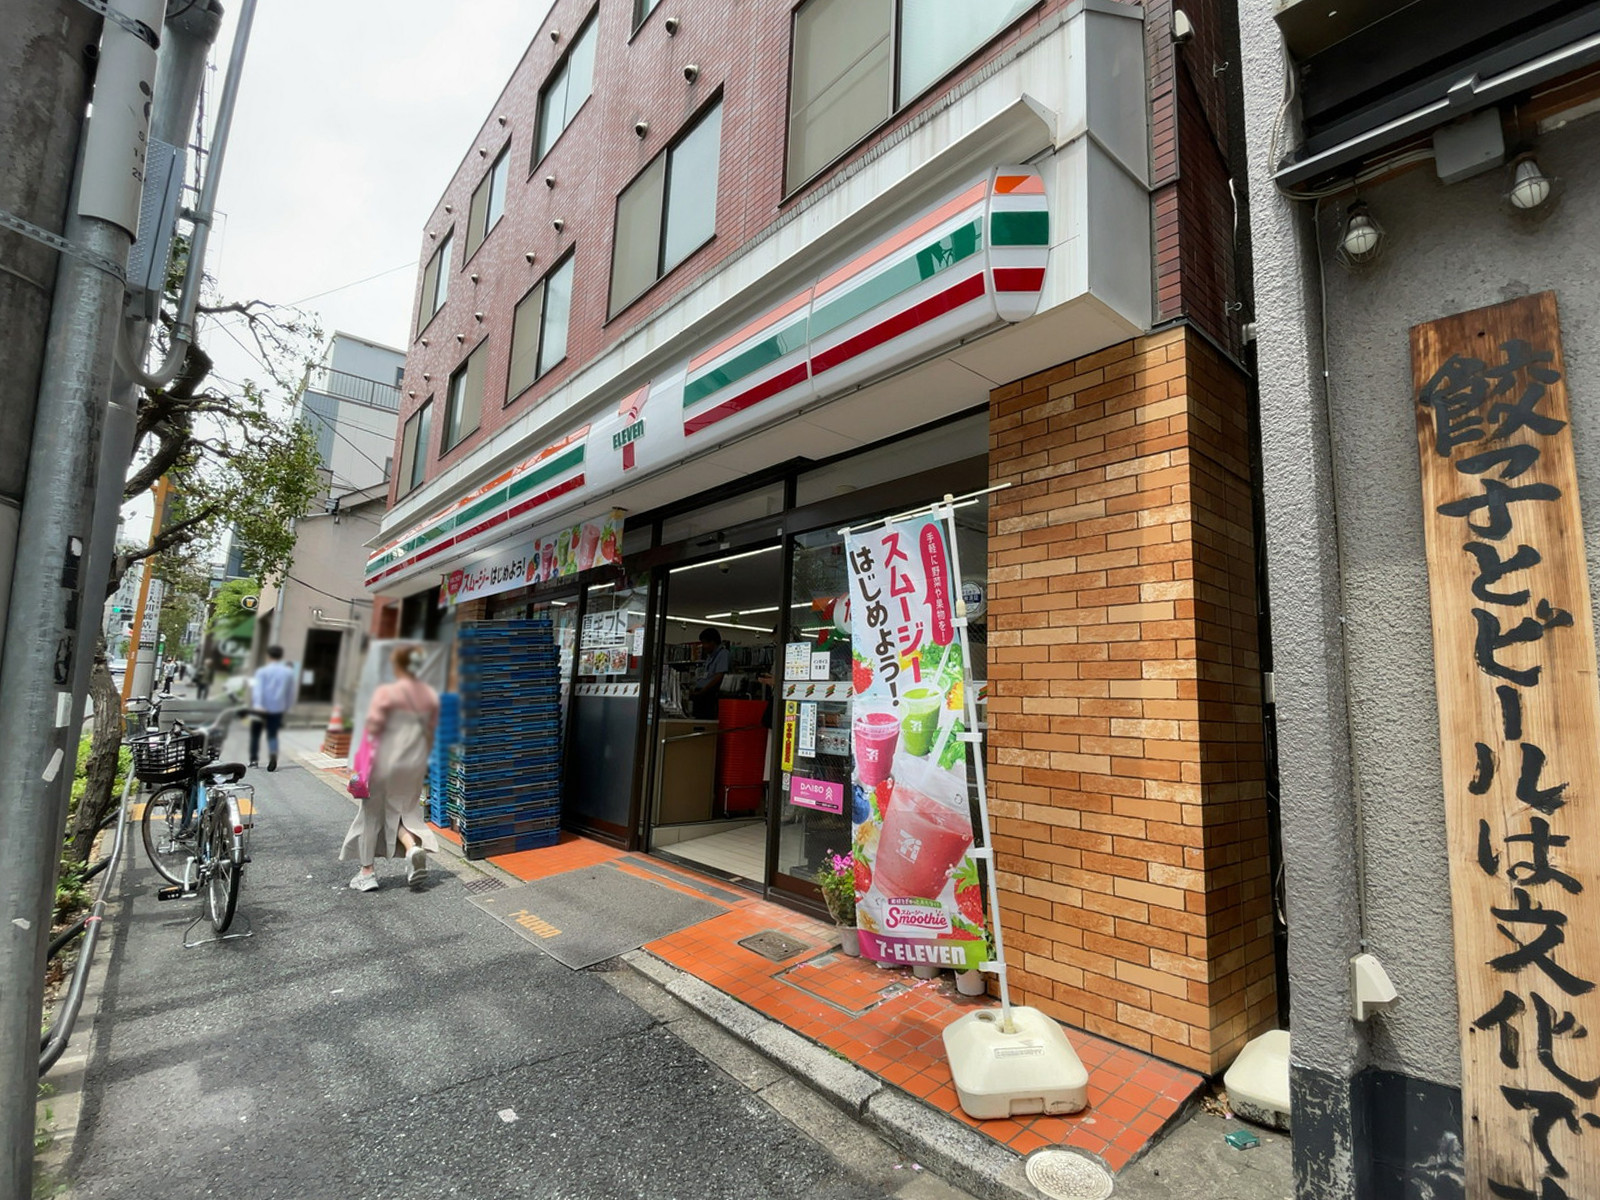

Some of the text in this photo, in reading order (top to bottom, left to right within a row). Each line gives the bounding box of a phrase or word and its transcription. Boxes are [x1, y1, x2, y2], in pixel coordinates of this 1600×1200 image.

[881, 532, 924, 684] スムージー
[886, 906, 948, 929] Smoothie
